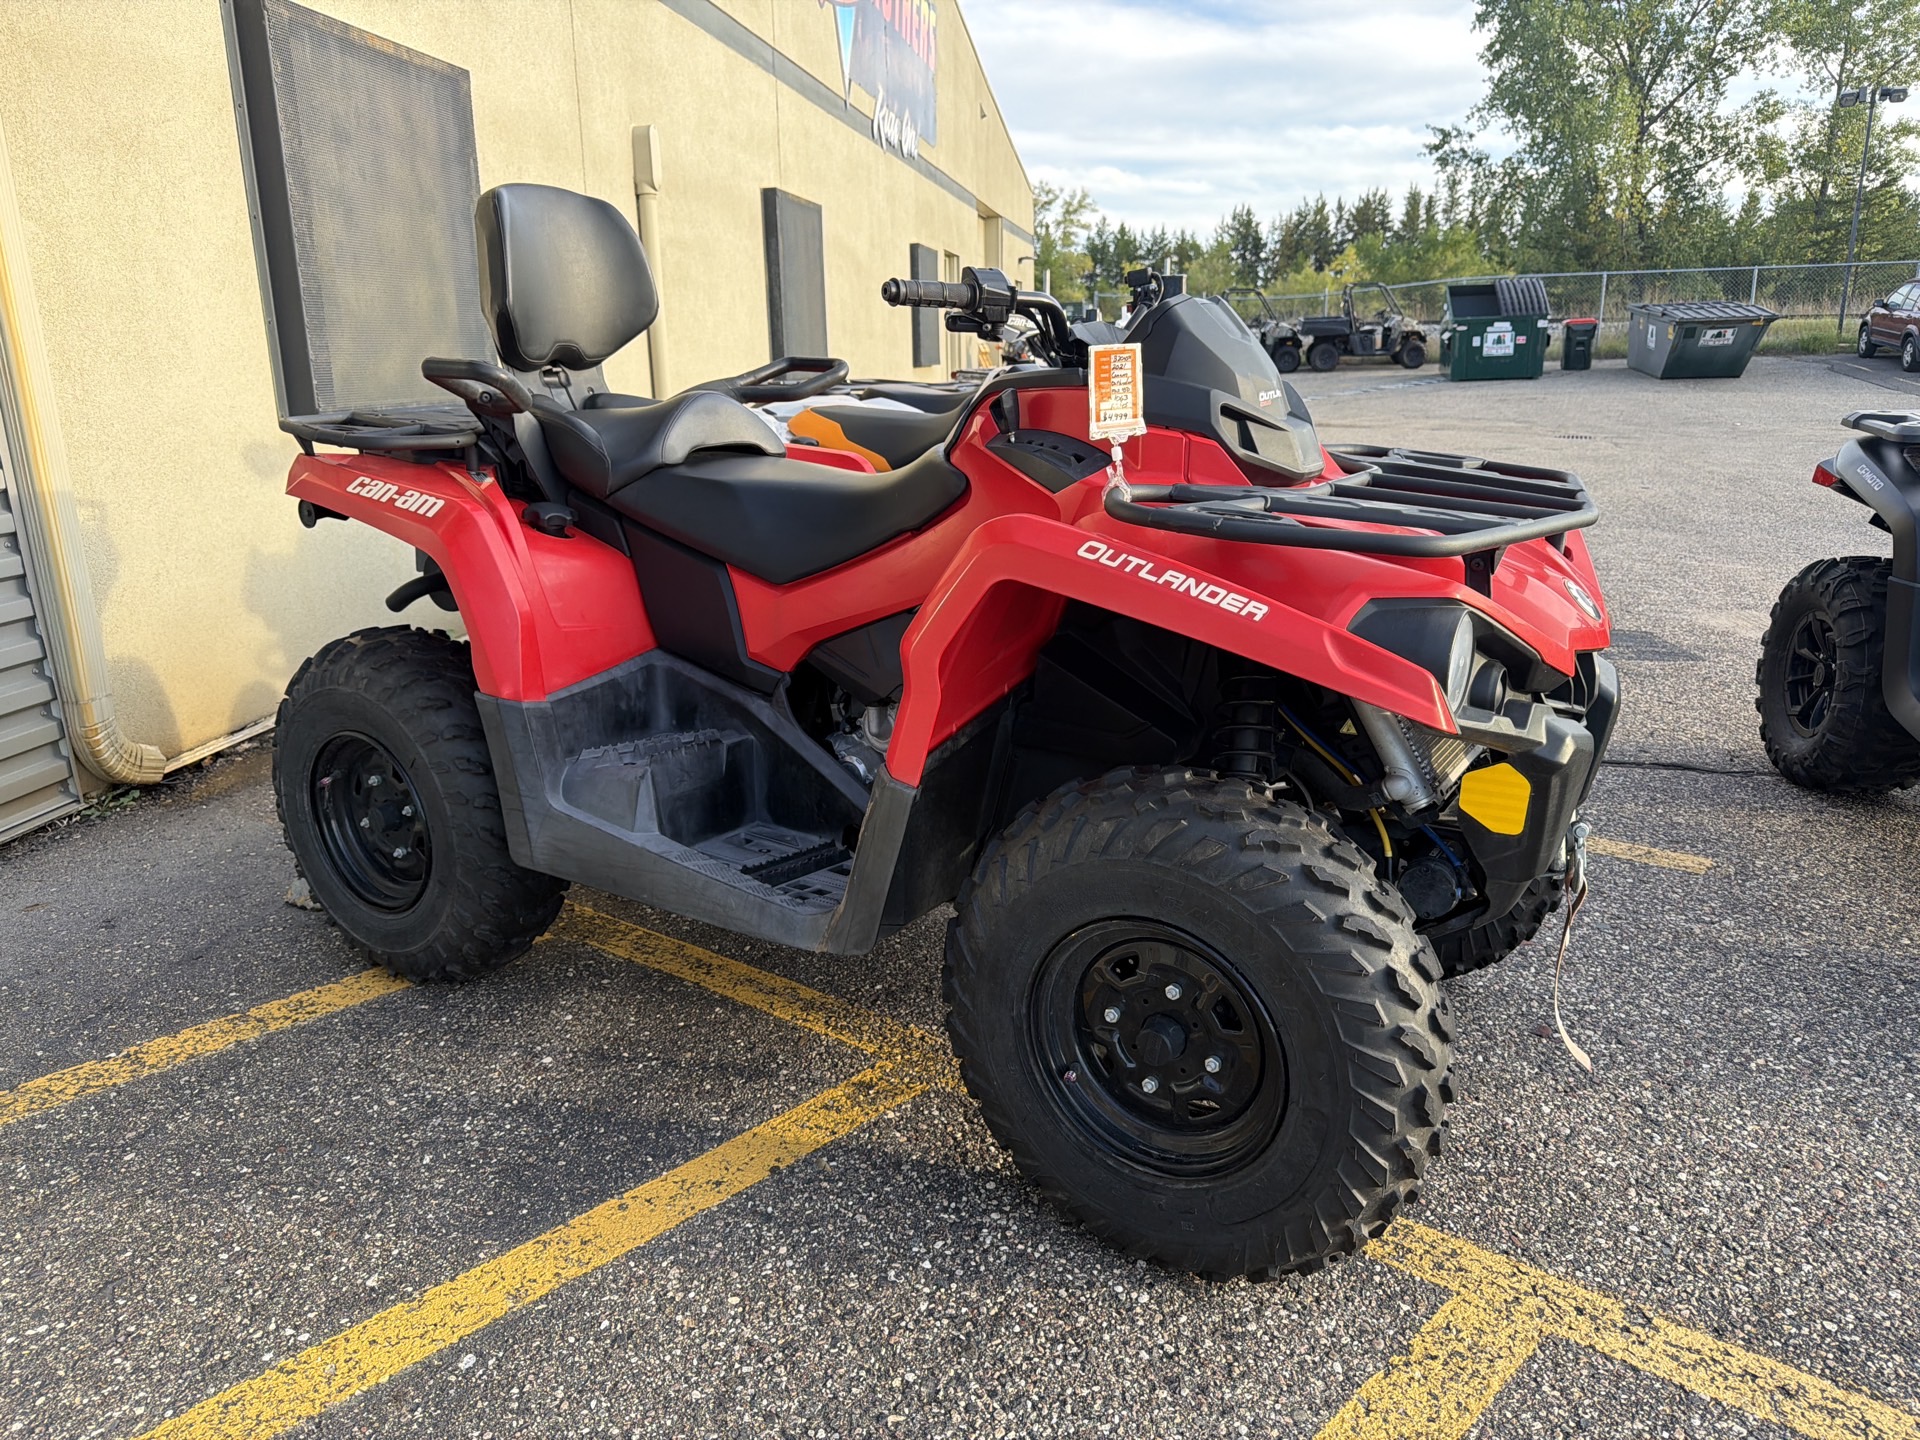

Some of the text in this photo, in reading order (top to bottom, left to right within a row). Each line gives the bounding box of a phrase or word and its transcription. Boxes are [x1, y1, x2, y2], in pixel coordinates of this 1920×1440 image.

[346, 476, 445, 518] can-am
[1856, 464, 1884, 491] CFMOTO
[1077, 540, 1269, 622] OUTLANDER
